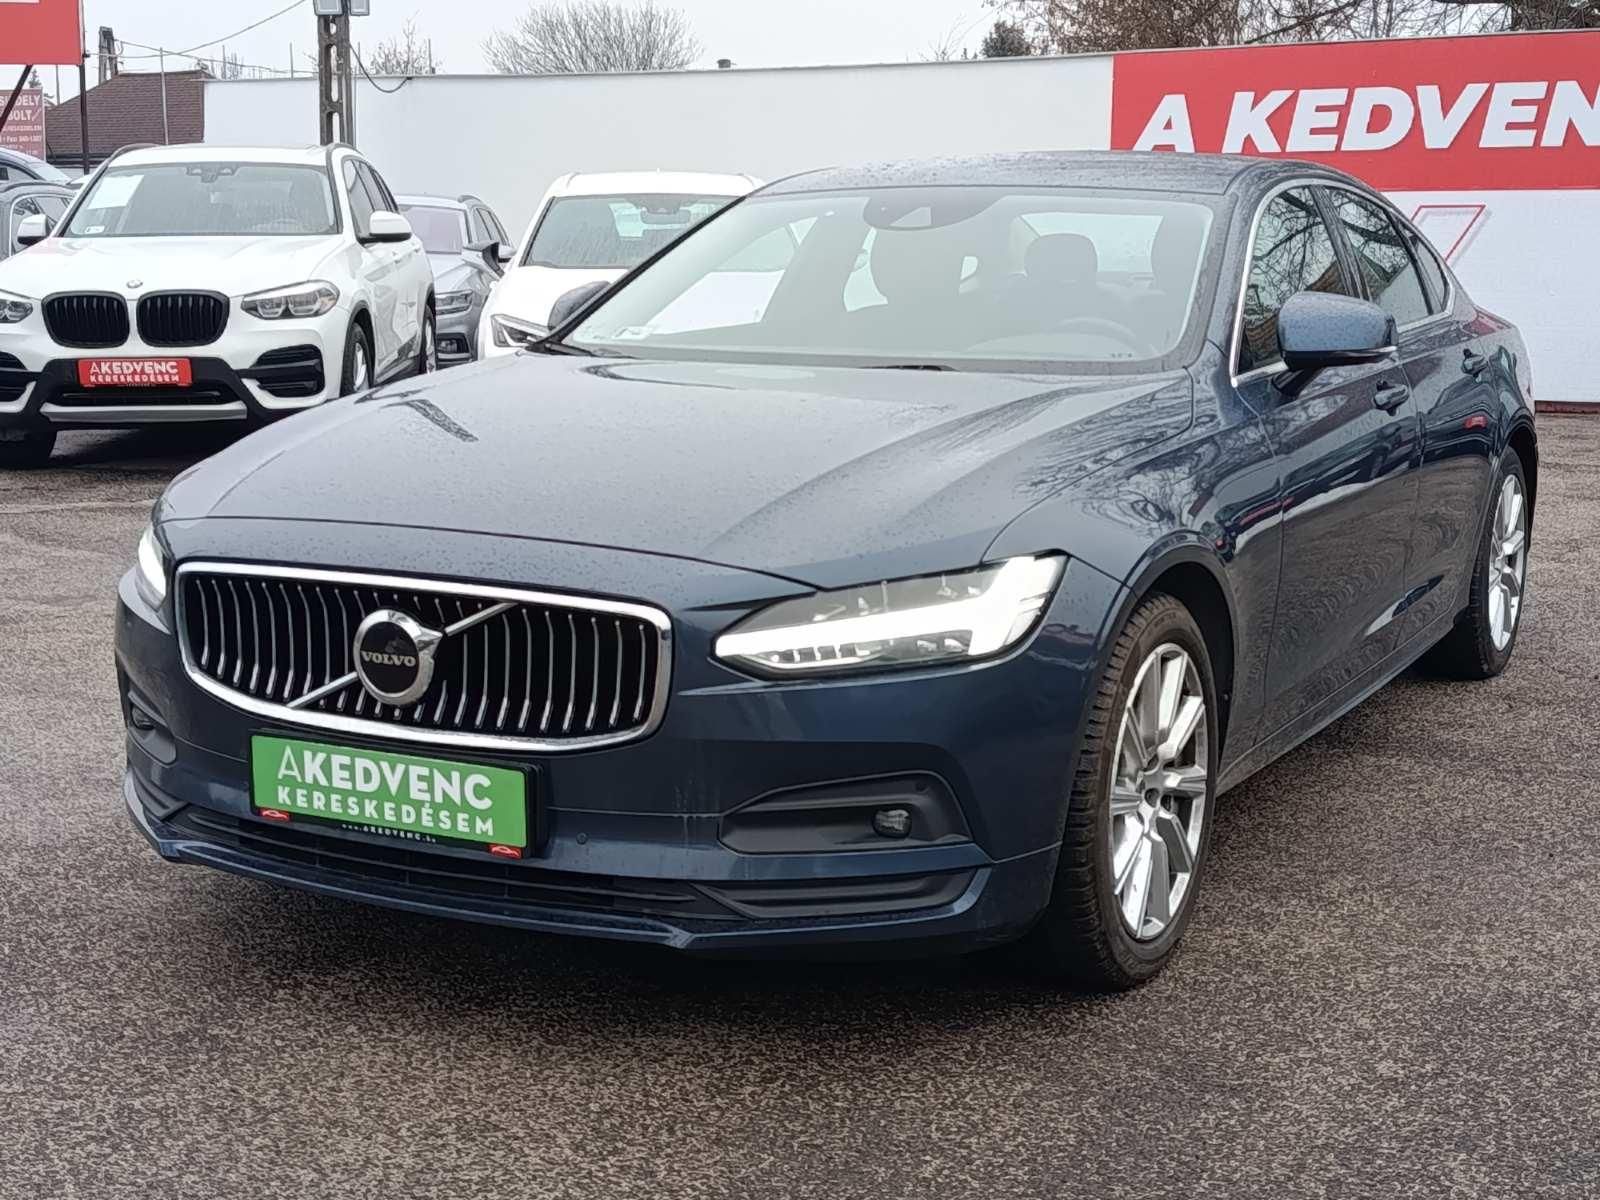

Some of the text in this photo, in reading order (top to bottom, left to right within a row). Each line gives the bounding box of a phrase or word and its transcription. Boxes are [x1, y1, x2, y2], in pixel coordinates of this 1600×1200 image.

[1131, 93, 1195, 152] A
[361, 650, 417, 667] VOLVO
[277, 785, 495, 837] KERESKEDÉSEM
